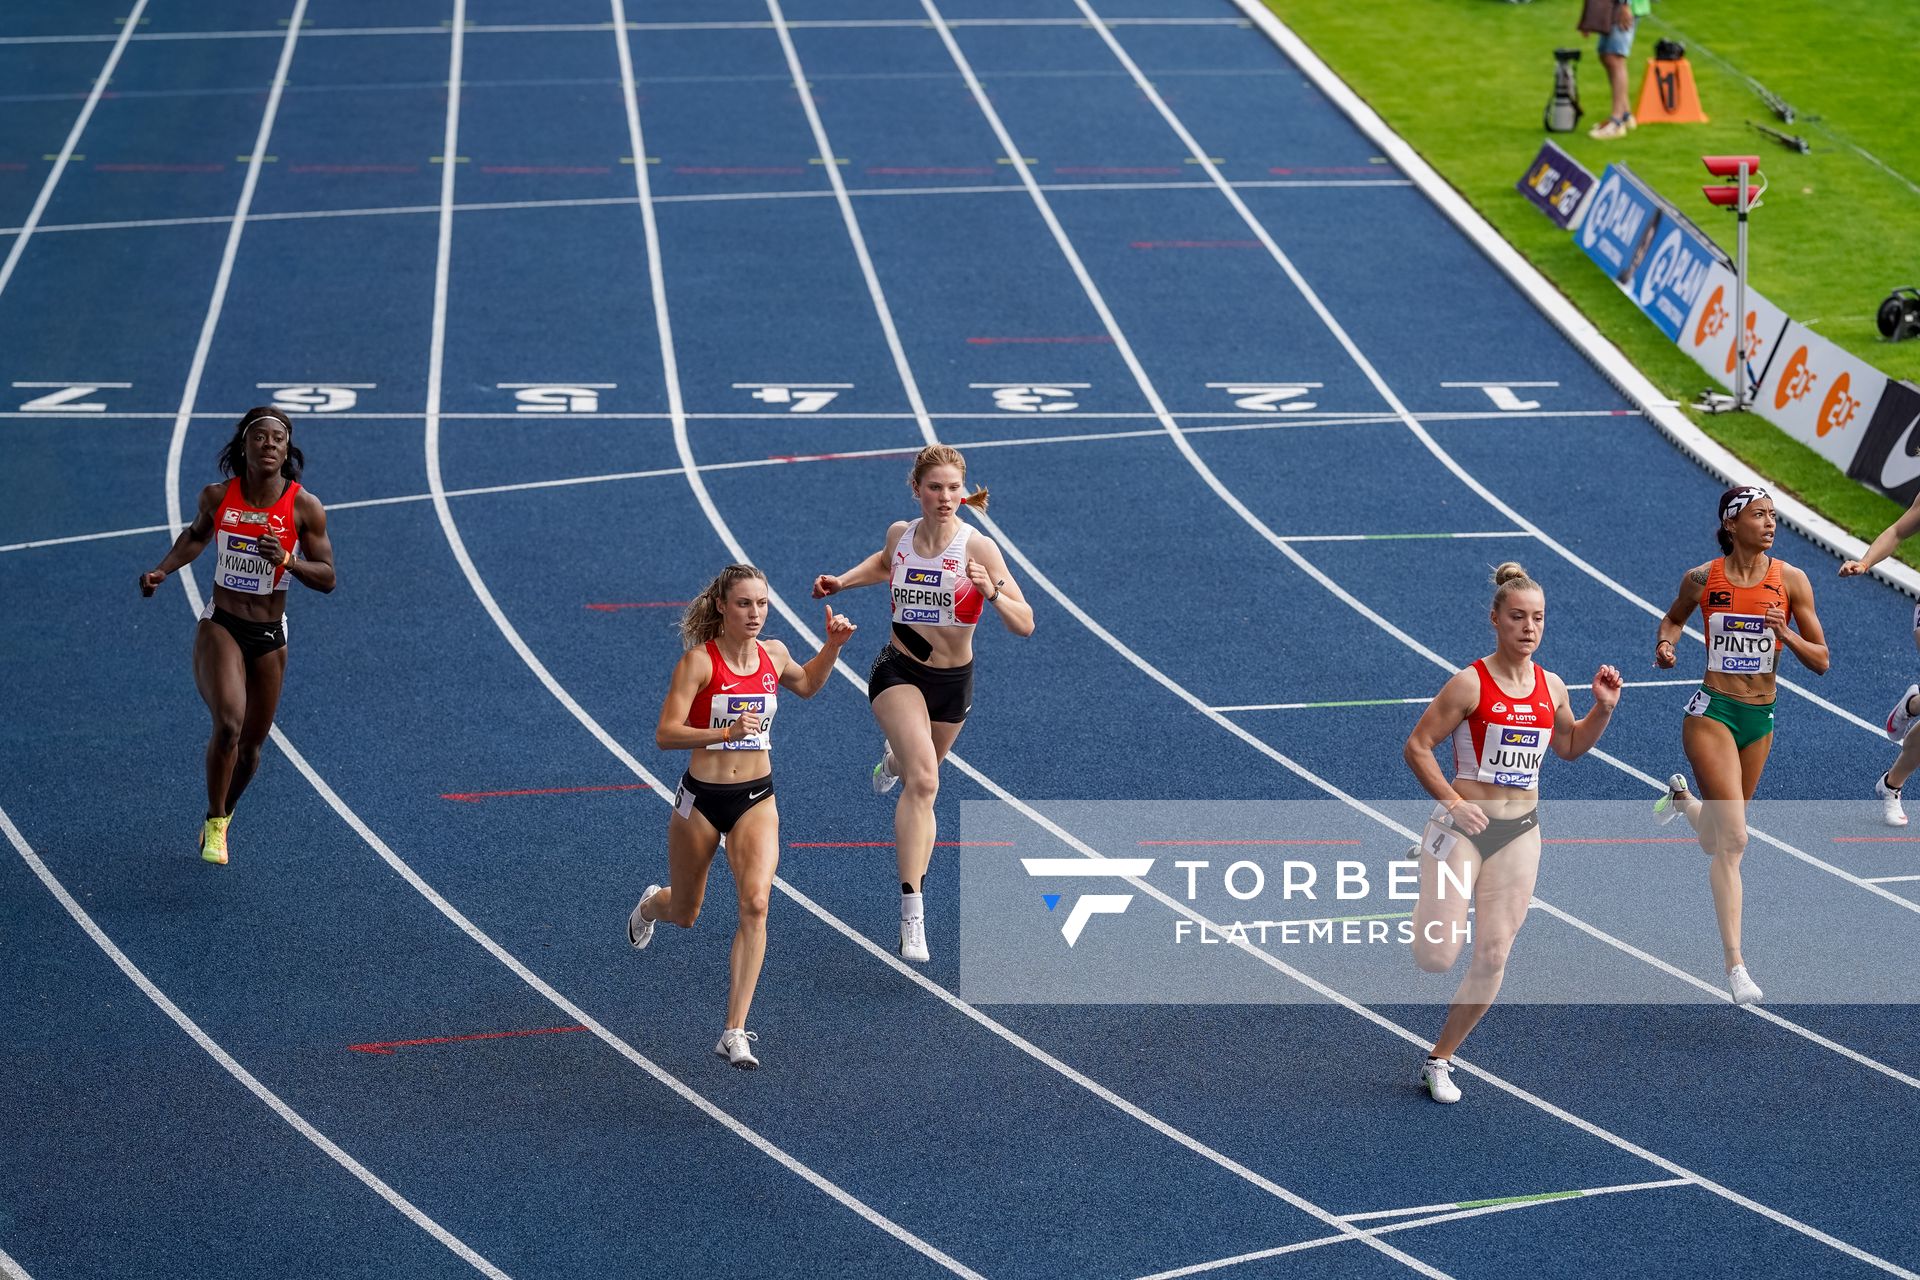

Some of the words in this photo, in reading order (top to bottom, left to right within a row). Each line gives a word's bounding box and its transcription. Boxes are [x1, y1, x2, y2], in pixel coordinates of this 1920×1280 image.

[19, 387, 107, 412] 7
[272, 387, 357, 412] 6
[514, 387, 599, 412] 5
[752, 387, 839, 412] 4
[992, 387, 1080, 412] 3
[1226, 387, 1317, 412] 2
[1482, 386, 1541, 411] 1
[237, 578, 258, 588] PLAN
[924, 574, 938, 584] GLS
[893, 587, 952, 607] PREPENS
[917, 611, 939, 619] PLAN
[1744, 622, 1761, 631] GLS
[1713, 635, 1772, 653] PINTO
[1689, 691, 1702, 712] 3
[1521, 735, 1537, 744] GLS
[1489, 750, 1542, 770] JUNK
[1432, 833, 1446, 855] 4
